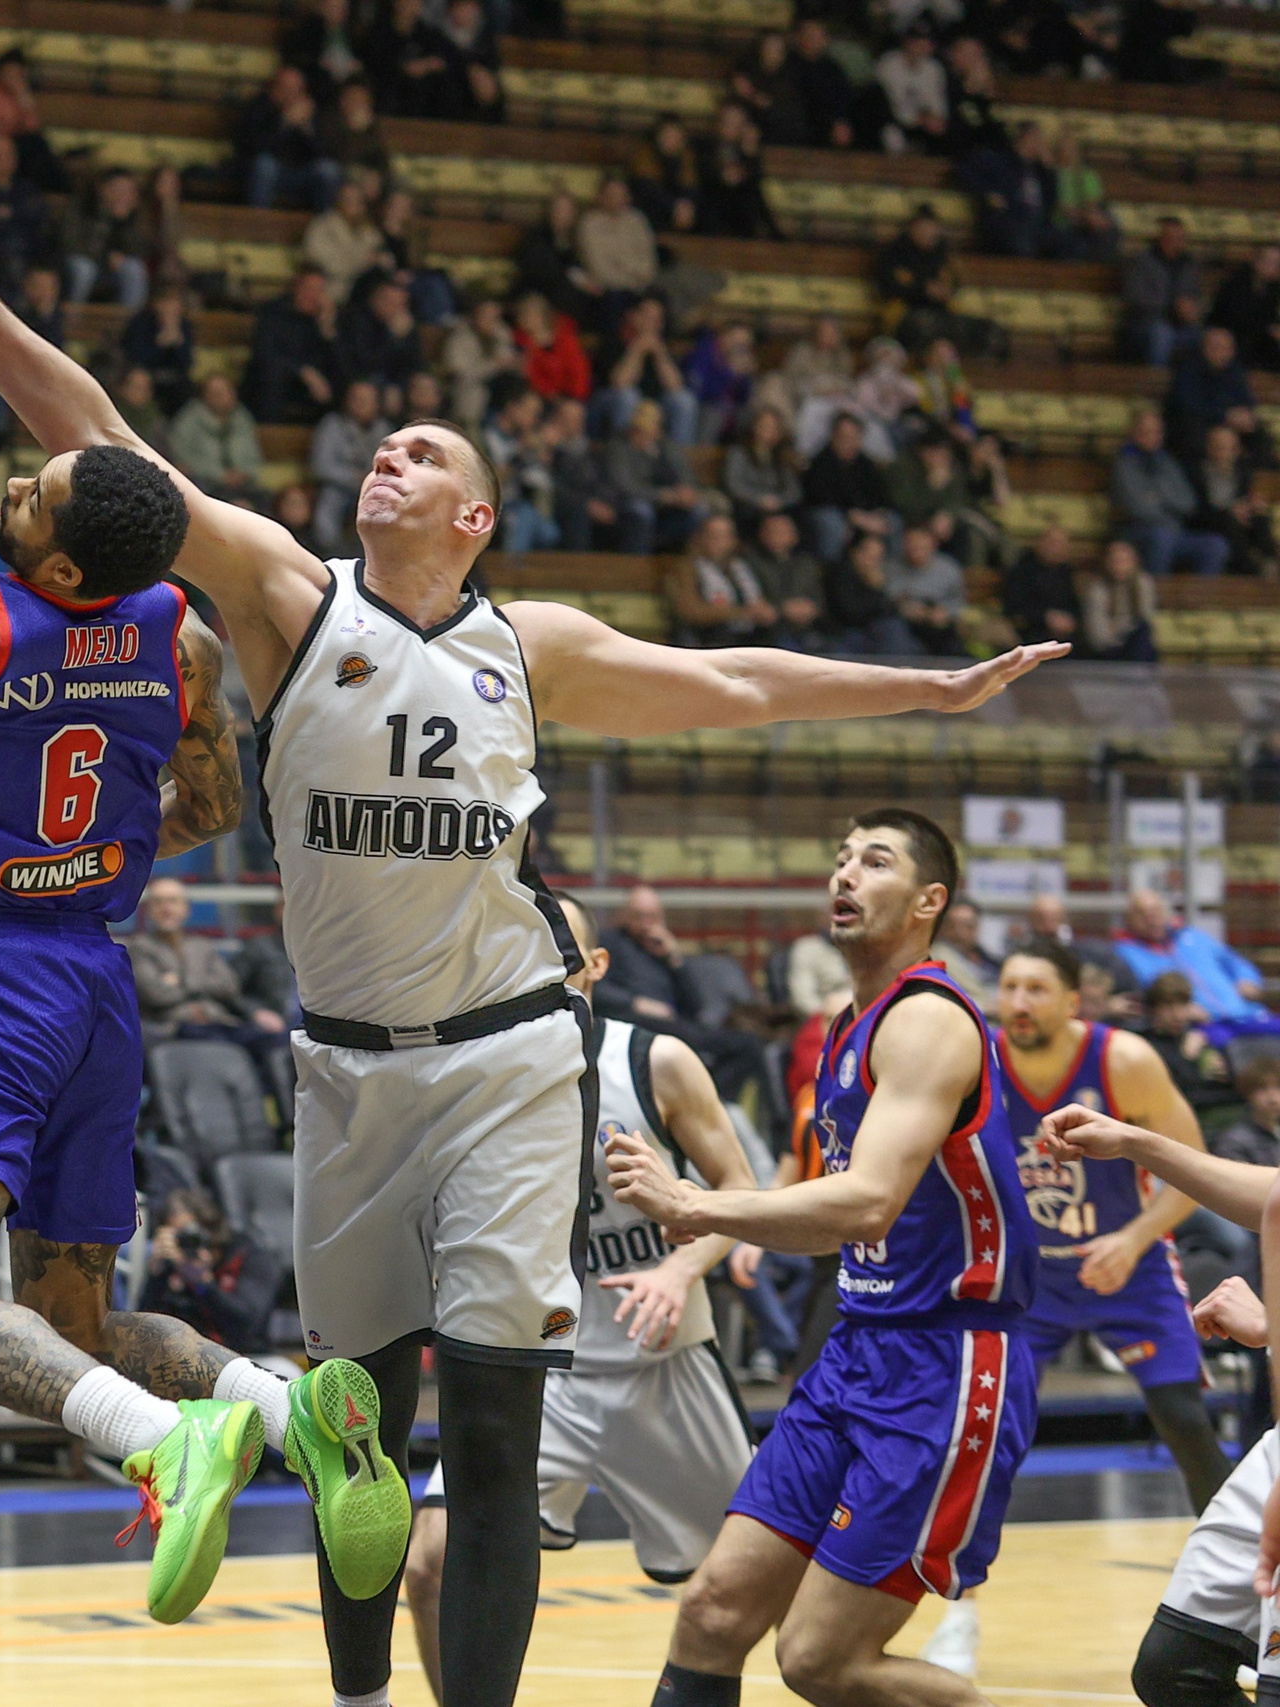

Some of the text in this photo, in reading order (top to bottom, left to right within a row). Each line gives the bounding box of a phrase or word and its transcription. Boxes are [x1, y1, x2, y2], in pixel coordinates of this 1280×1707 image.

[61, 623, 139, 669] MELO
[65, 680, 171, 699] НОРНИКЕЛЬ
[386, 714, 458, 779] 12
[37, 724, 109, 848] 6
[10, 851, 99, 889] WINLNE
